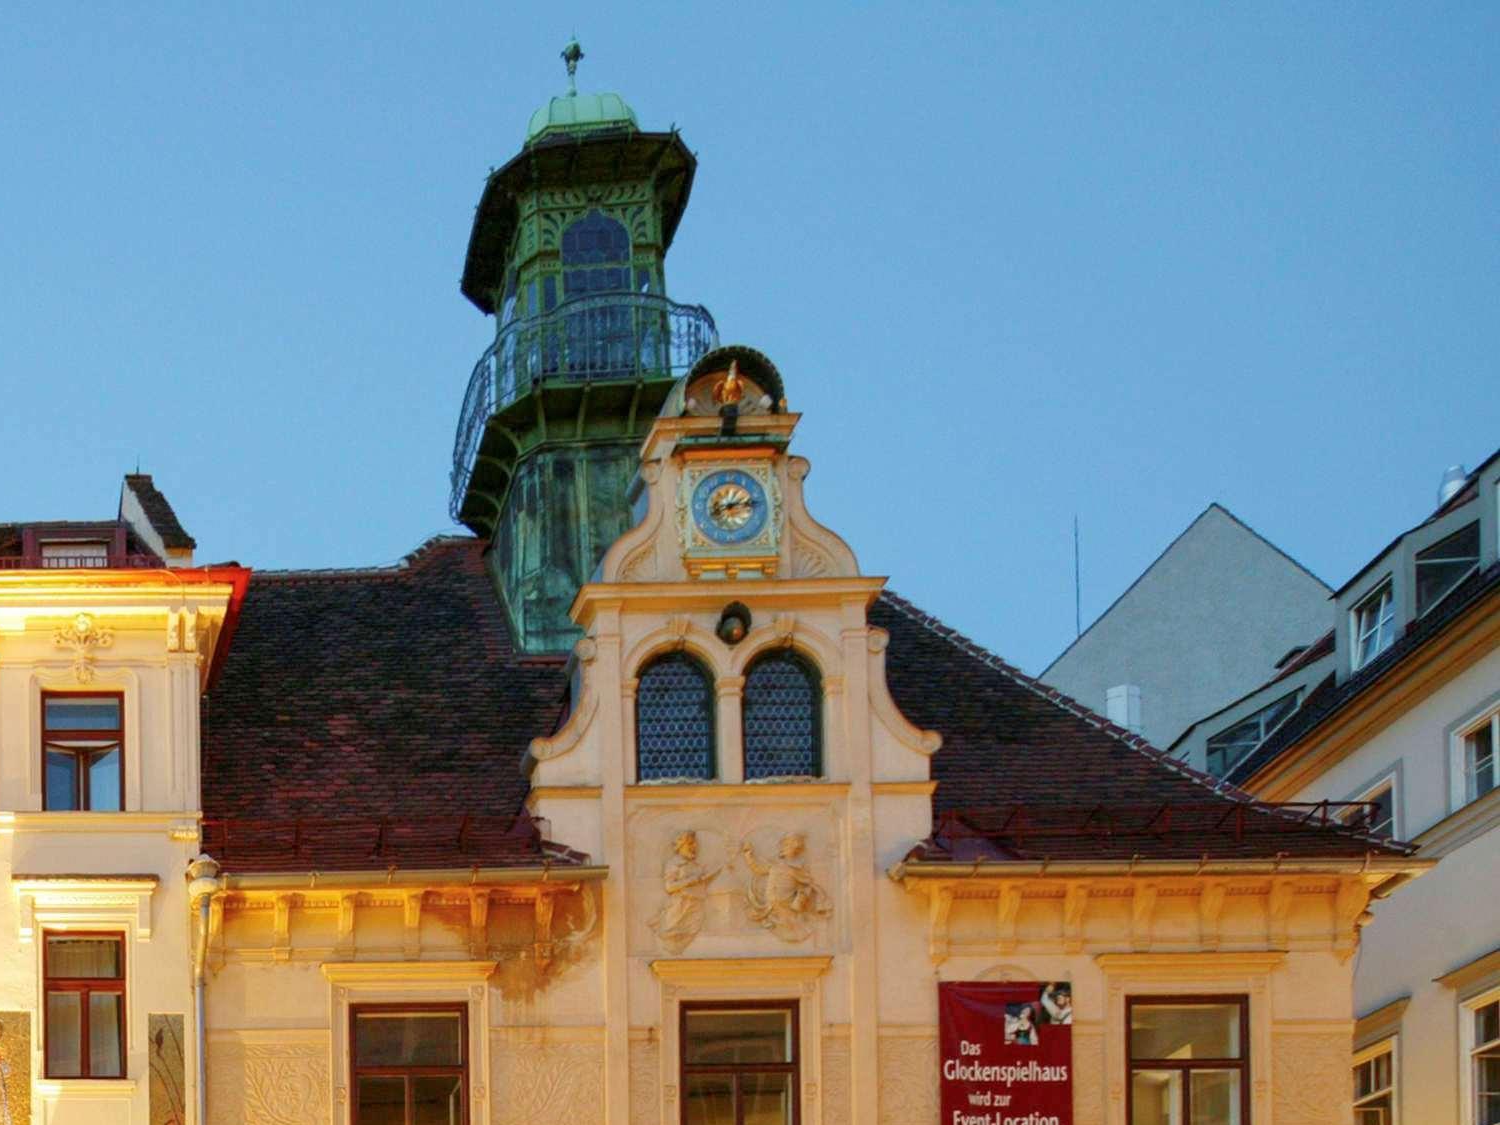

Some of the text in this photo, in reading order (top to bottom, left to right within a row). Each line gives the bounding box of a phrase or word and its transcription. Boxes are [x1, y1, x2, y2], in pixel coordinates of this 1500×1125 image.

[960, 1040, 981, 1056] Das
[944, 1058, 1067, 1088] Glockenspielhaus
[968, 1090, 1011, 1107] wird zur
